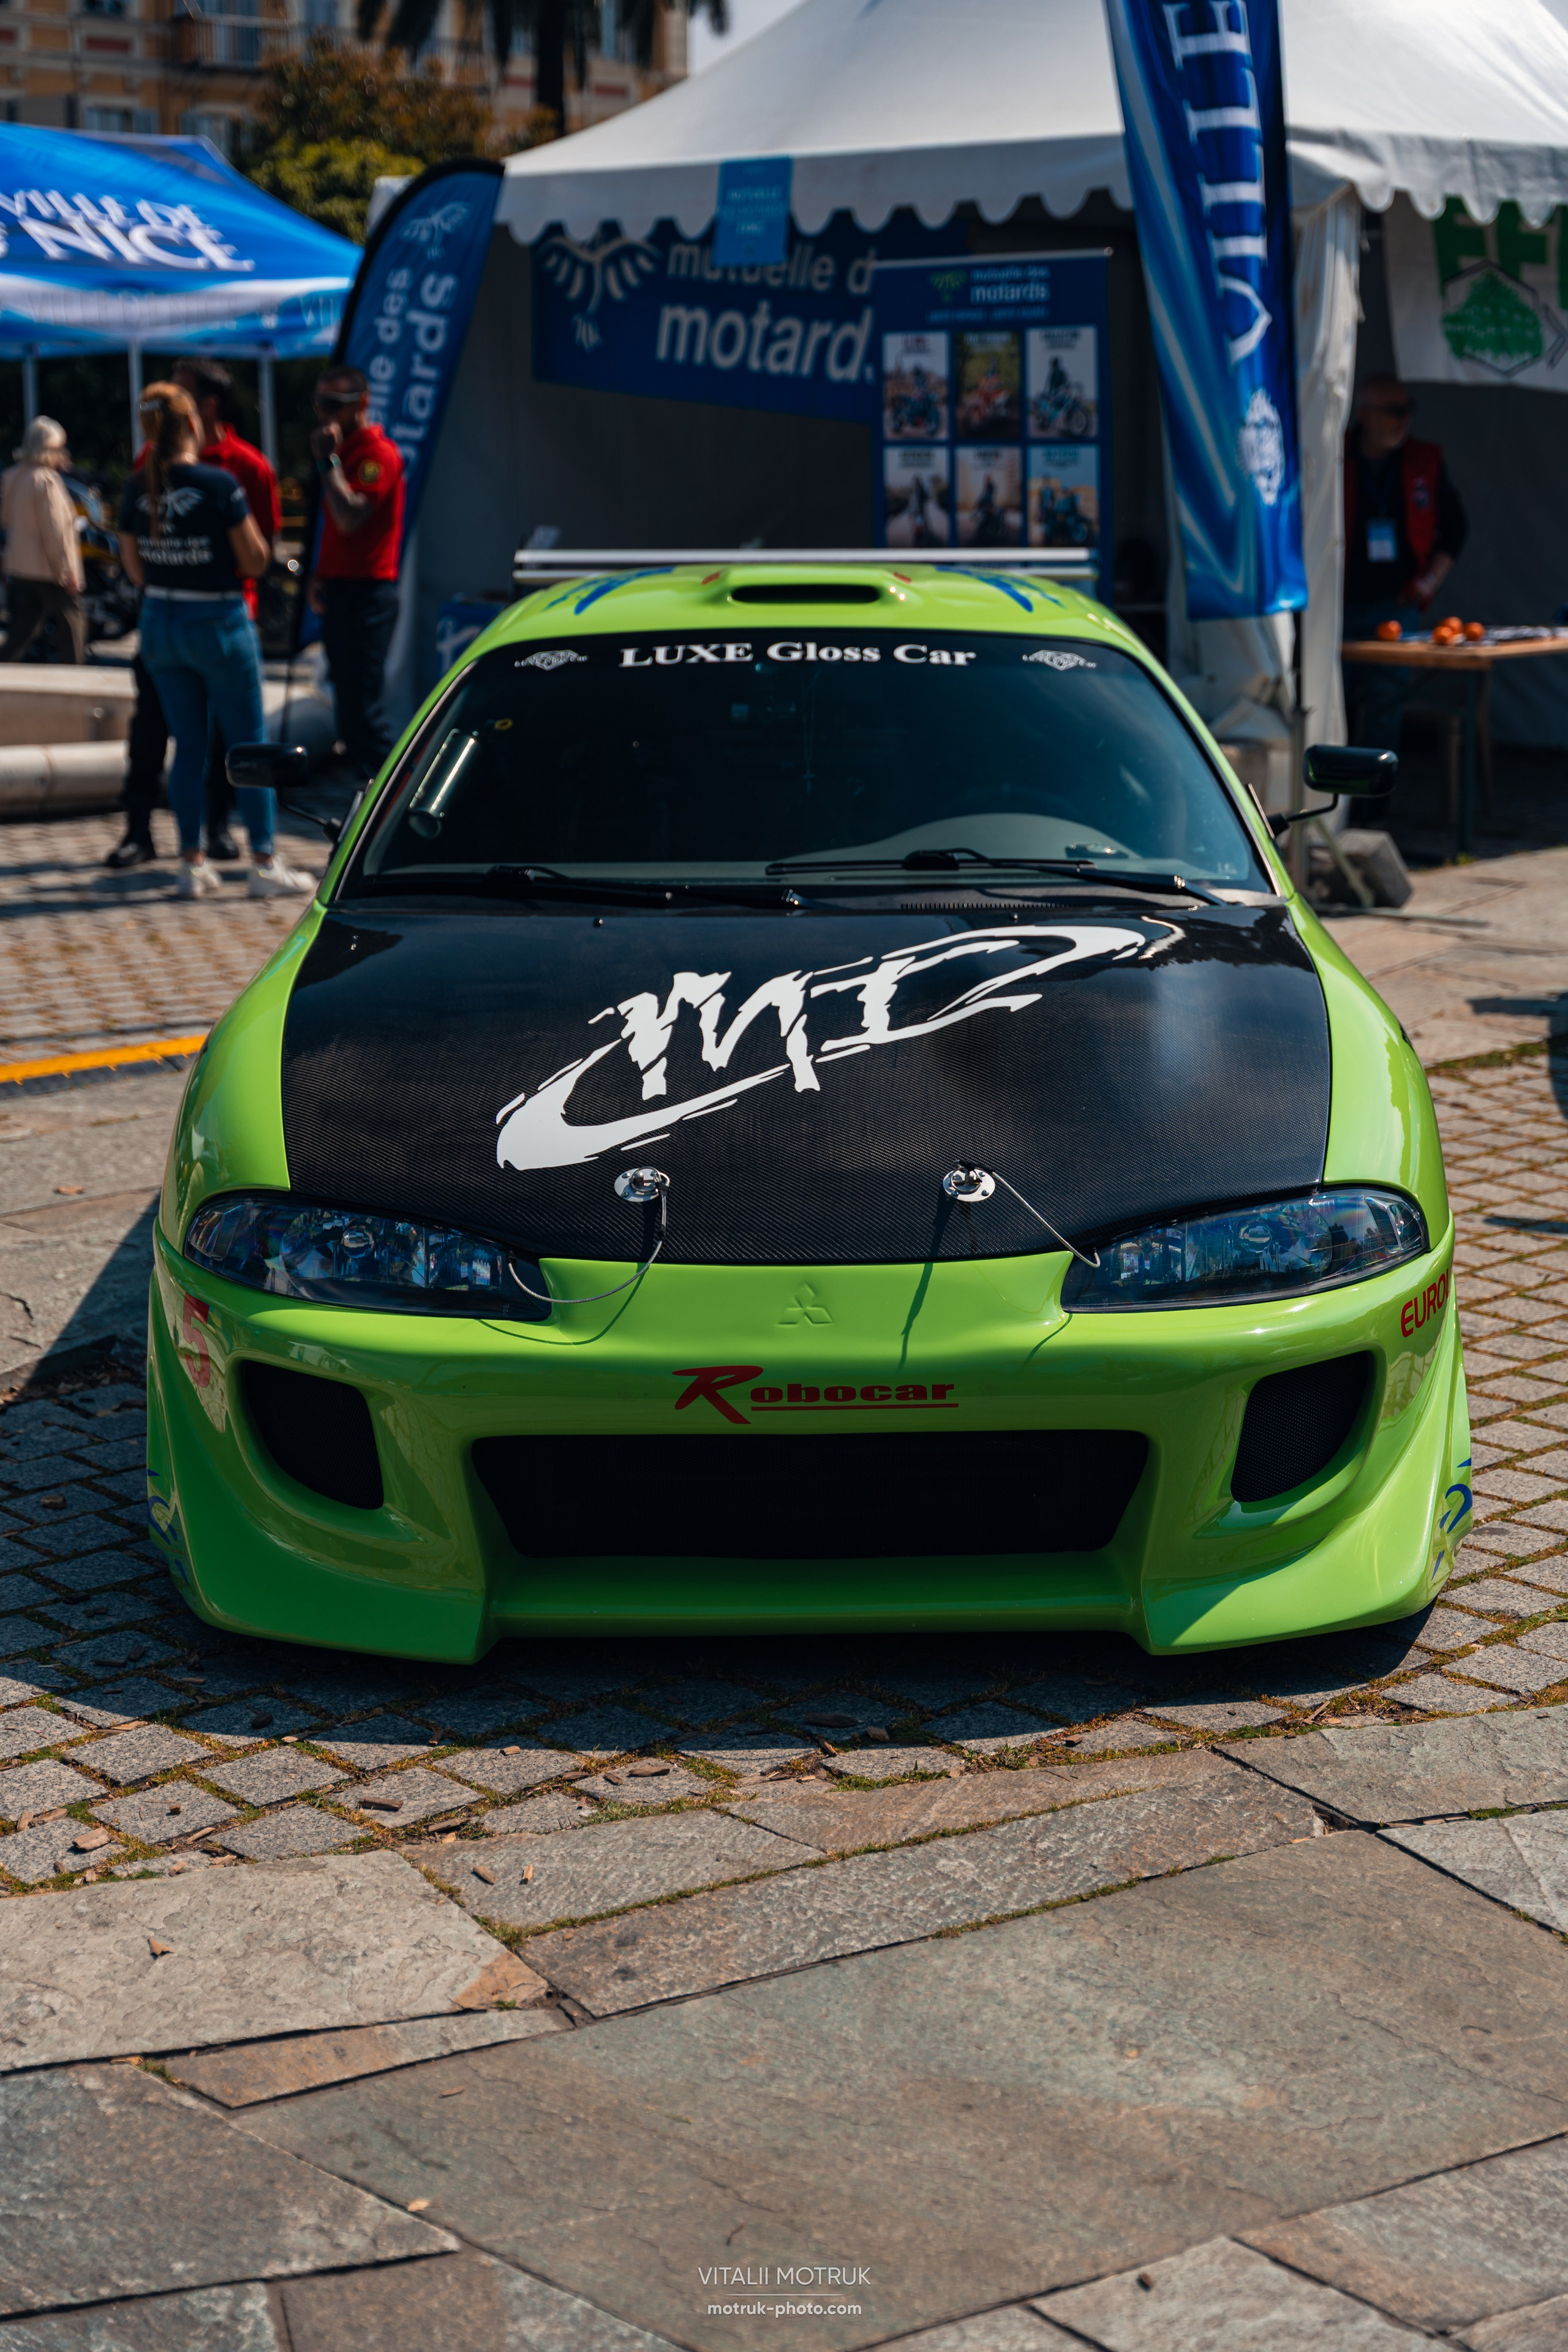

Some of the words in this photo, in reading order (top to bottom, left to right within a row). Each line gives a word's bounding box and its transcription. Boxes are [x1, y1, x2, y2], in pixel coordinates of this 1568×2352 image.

[1163, 0, 1272, 366] VILLE
[18, 213, 255, 271] NICE
[374, 268, 412, 344] des
[619, 643, 754, 668] LUXE
[766, 641, 881, 662] Gloss
[893, 644, 977, 666] Car
[671, 1365, 957, 1425] Robocar
